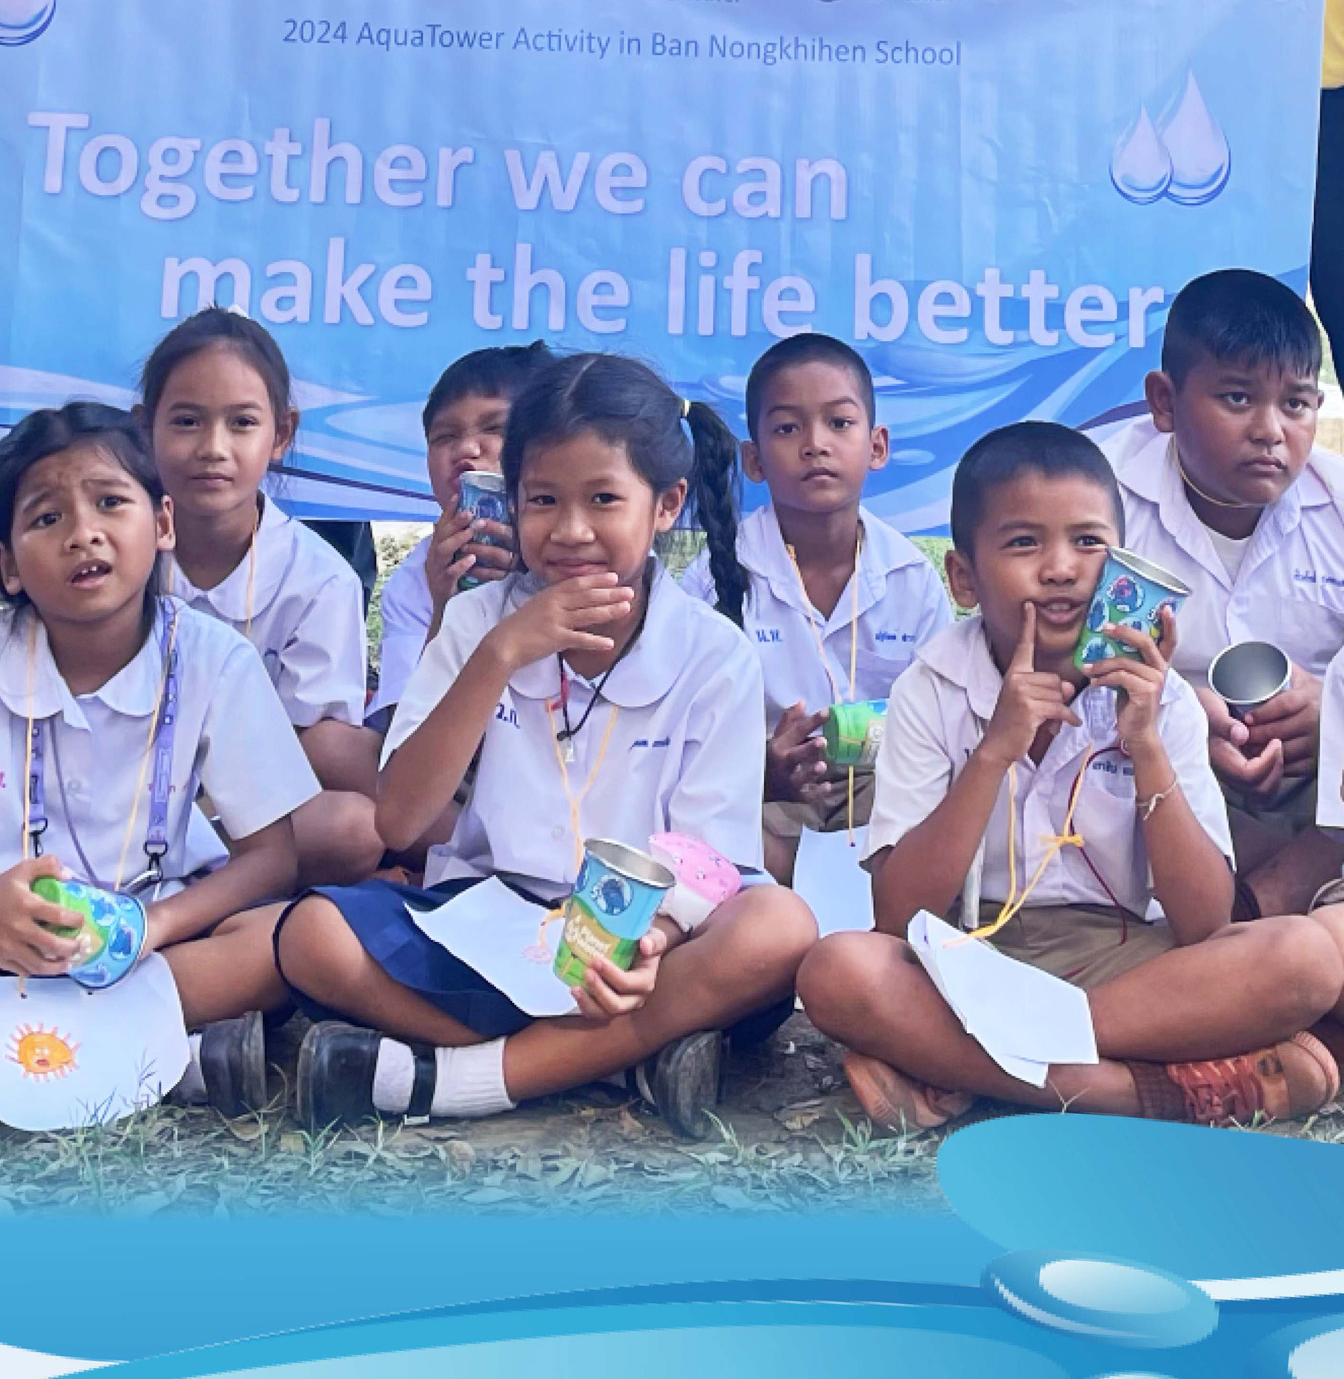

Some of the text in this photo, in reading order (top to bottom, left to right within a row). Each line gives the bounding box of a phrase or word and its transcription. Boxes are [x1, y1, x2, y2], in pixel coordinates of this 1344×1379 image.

[282, 18, 961, 66] 2024 AquaTower Activity in Ban Nongkhihen School
[27, 111, 849, 221] Together we can
[160, 237, 1165, 349] make the life better
